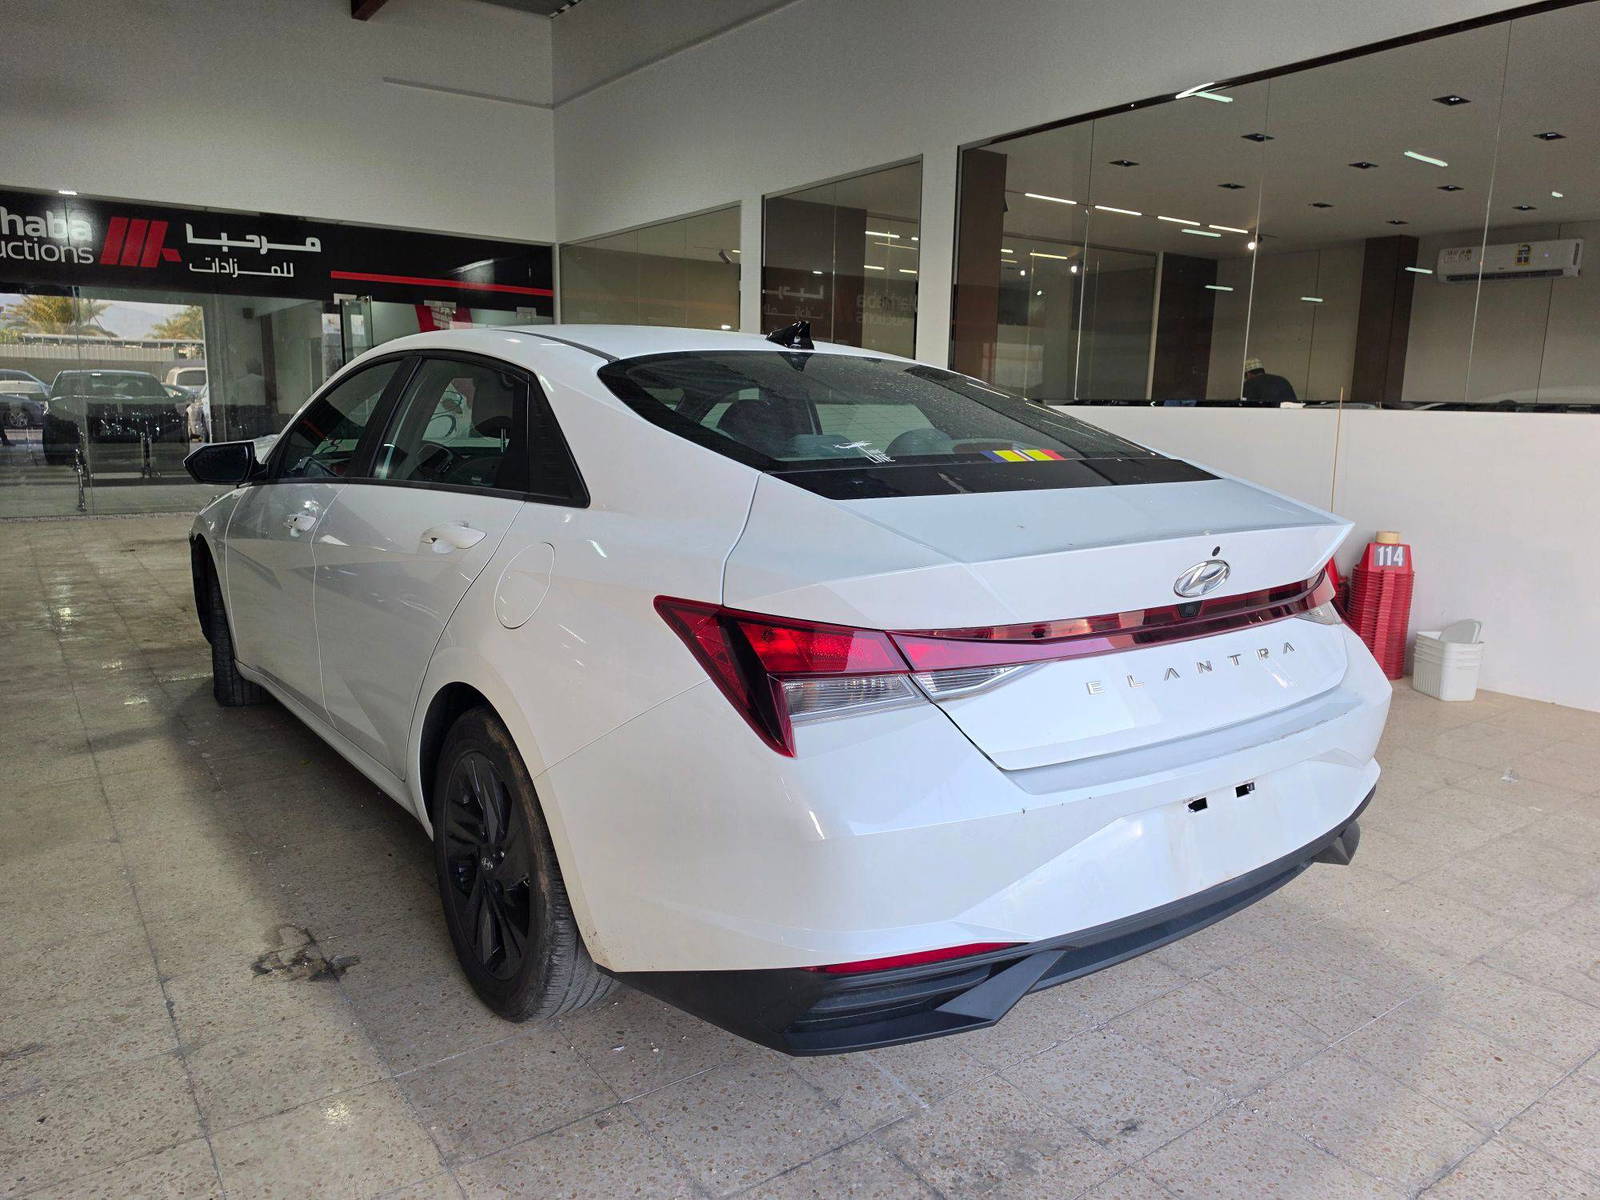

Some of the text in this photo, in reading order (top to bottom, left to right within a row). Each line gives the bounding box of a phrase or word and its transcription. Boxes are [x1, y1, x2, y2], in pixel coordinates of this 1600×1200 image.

[185, 223, 322, 255] مرحبا
[189, 257, 295, 278] للمزادات
[1377, 545, 1404, 567] 114
[1086, 641, 1296, 696] ELANTRA
